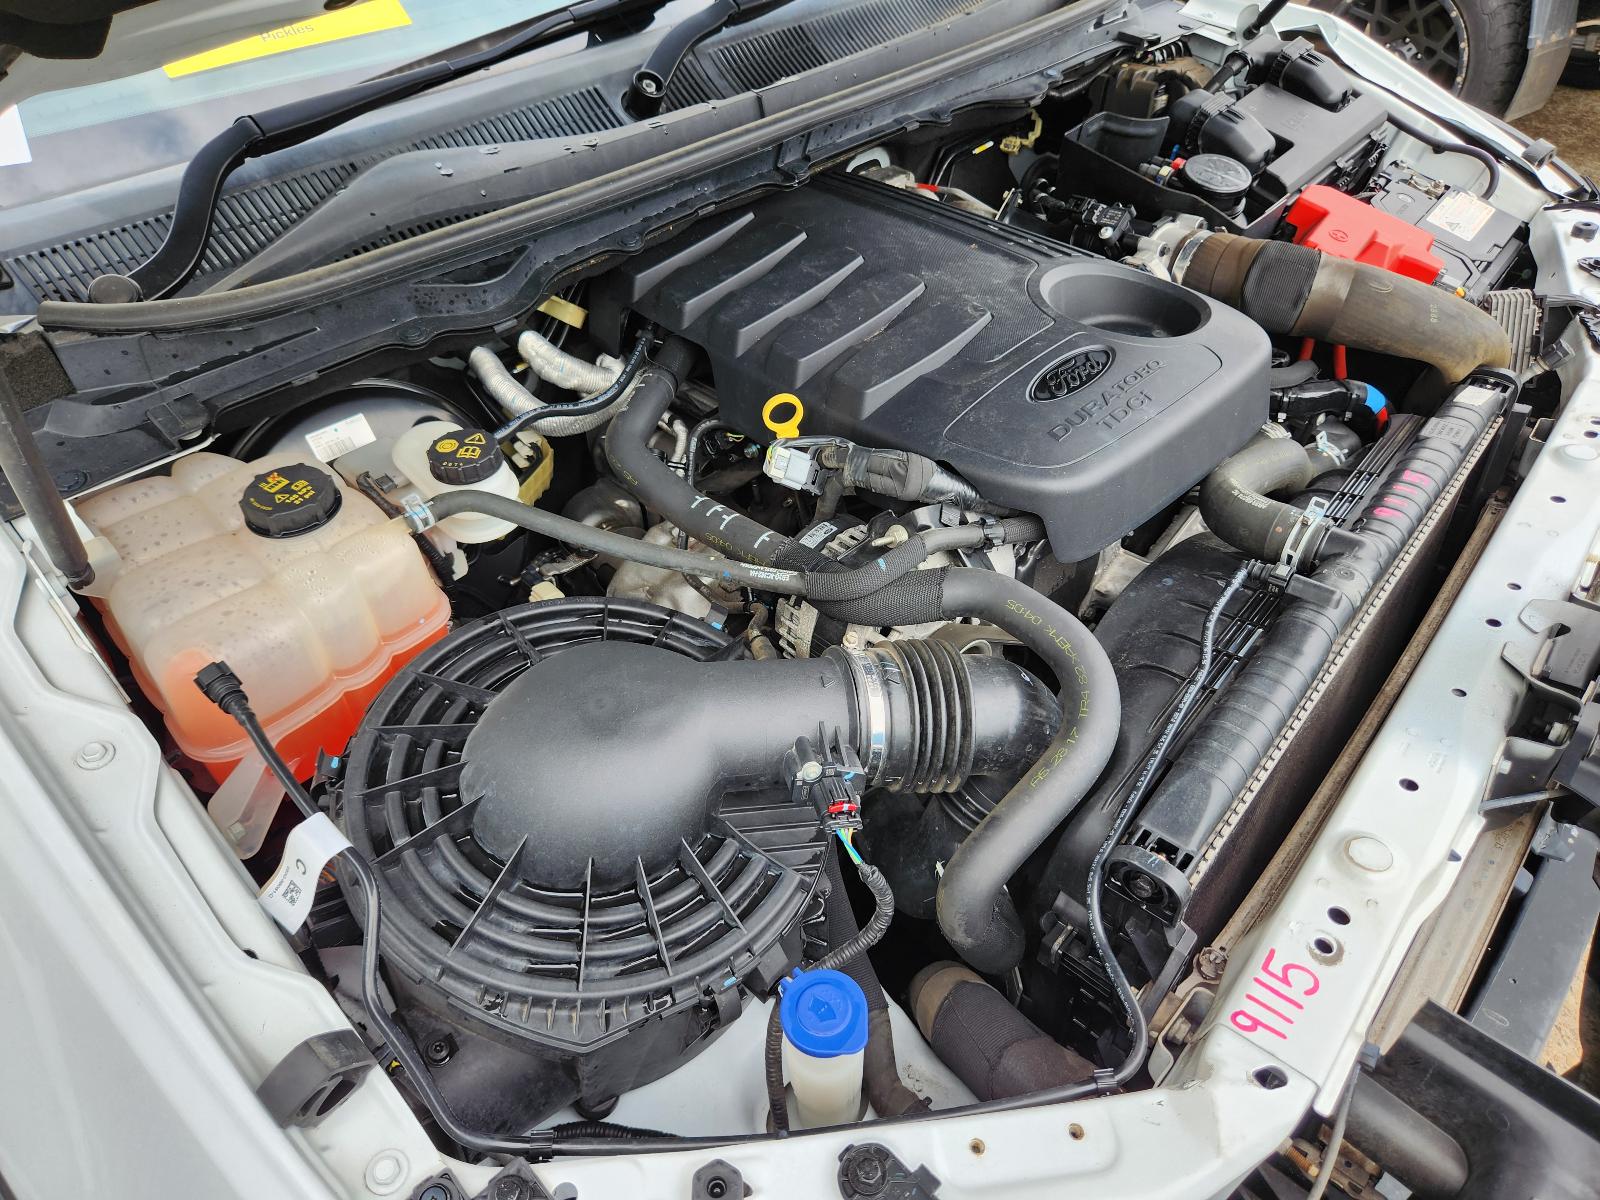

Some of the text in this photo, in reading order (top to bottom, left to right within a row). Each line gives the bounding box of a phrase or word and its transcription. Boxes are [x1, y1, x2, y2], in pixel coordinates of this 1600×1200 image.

[261, 24, 315, 42] Pickles
[1046, 352, 1103, 397] Ford
[1047, 359, 1165, 442] DURATORQ
[1230, 947, 1320, 1040] 9115
